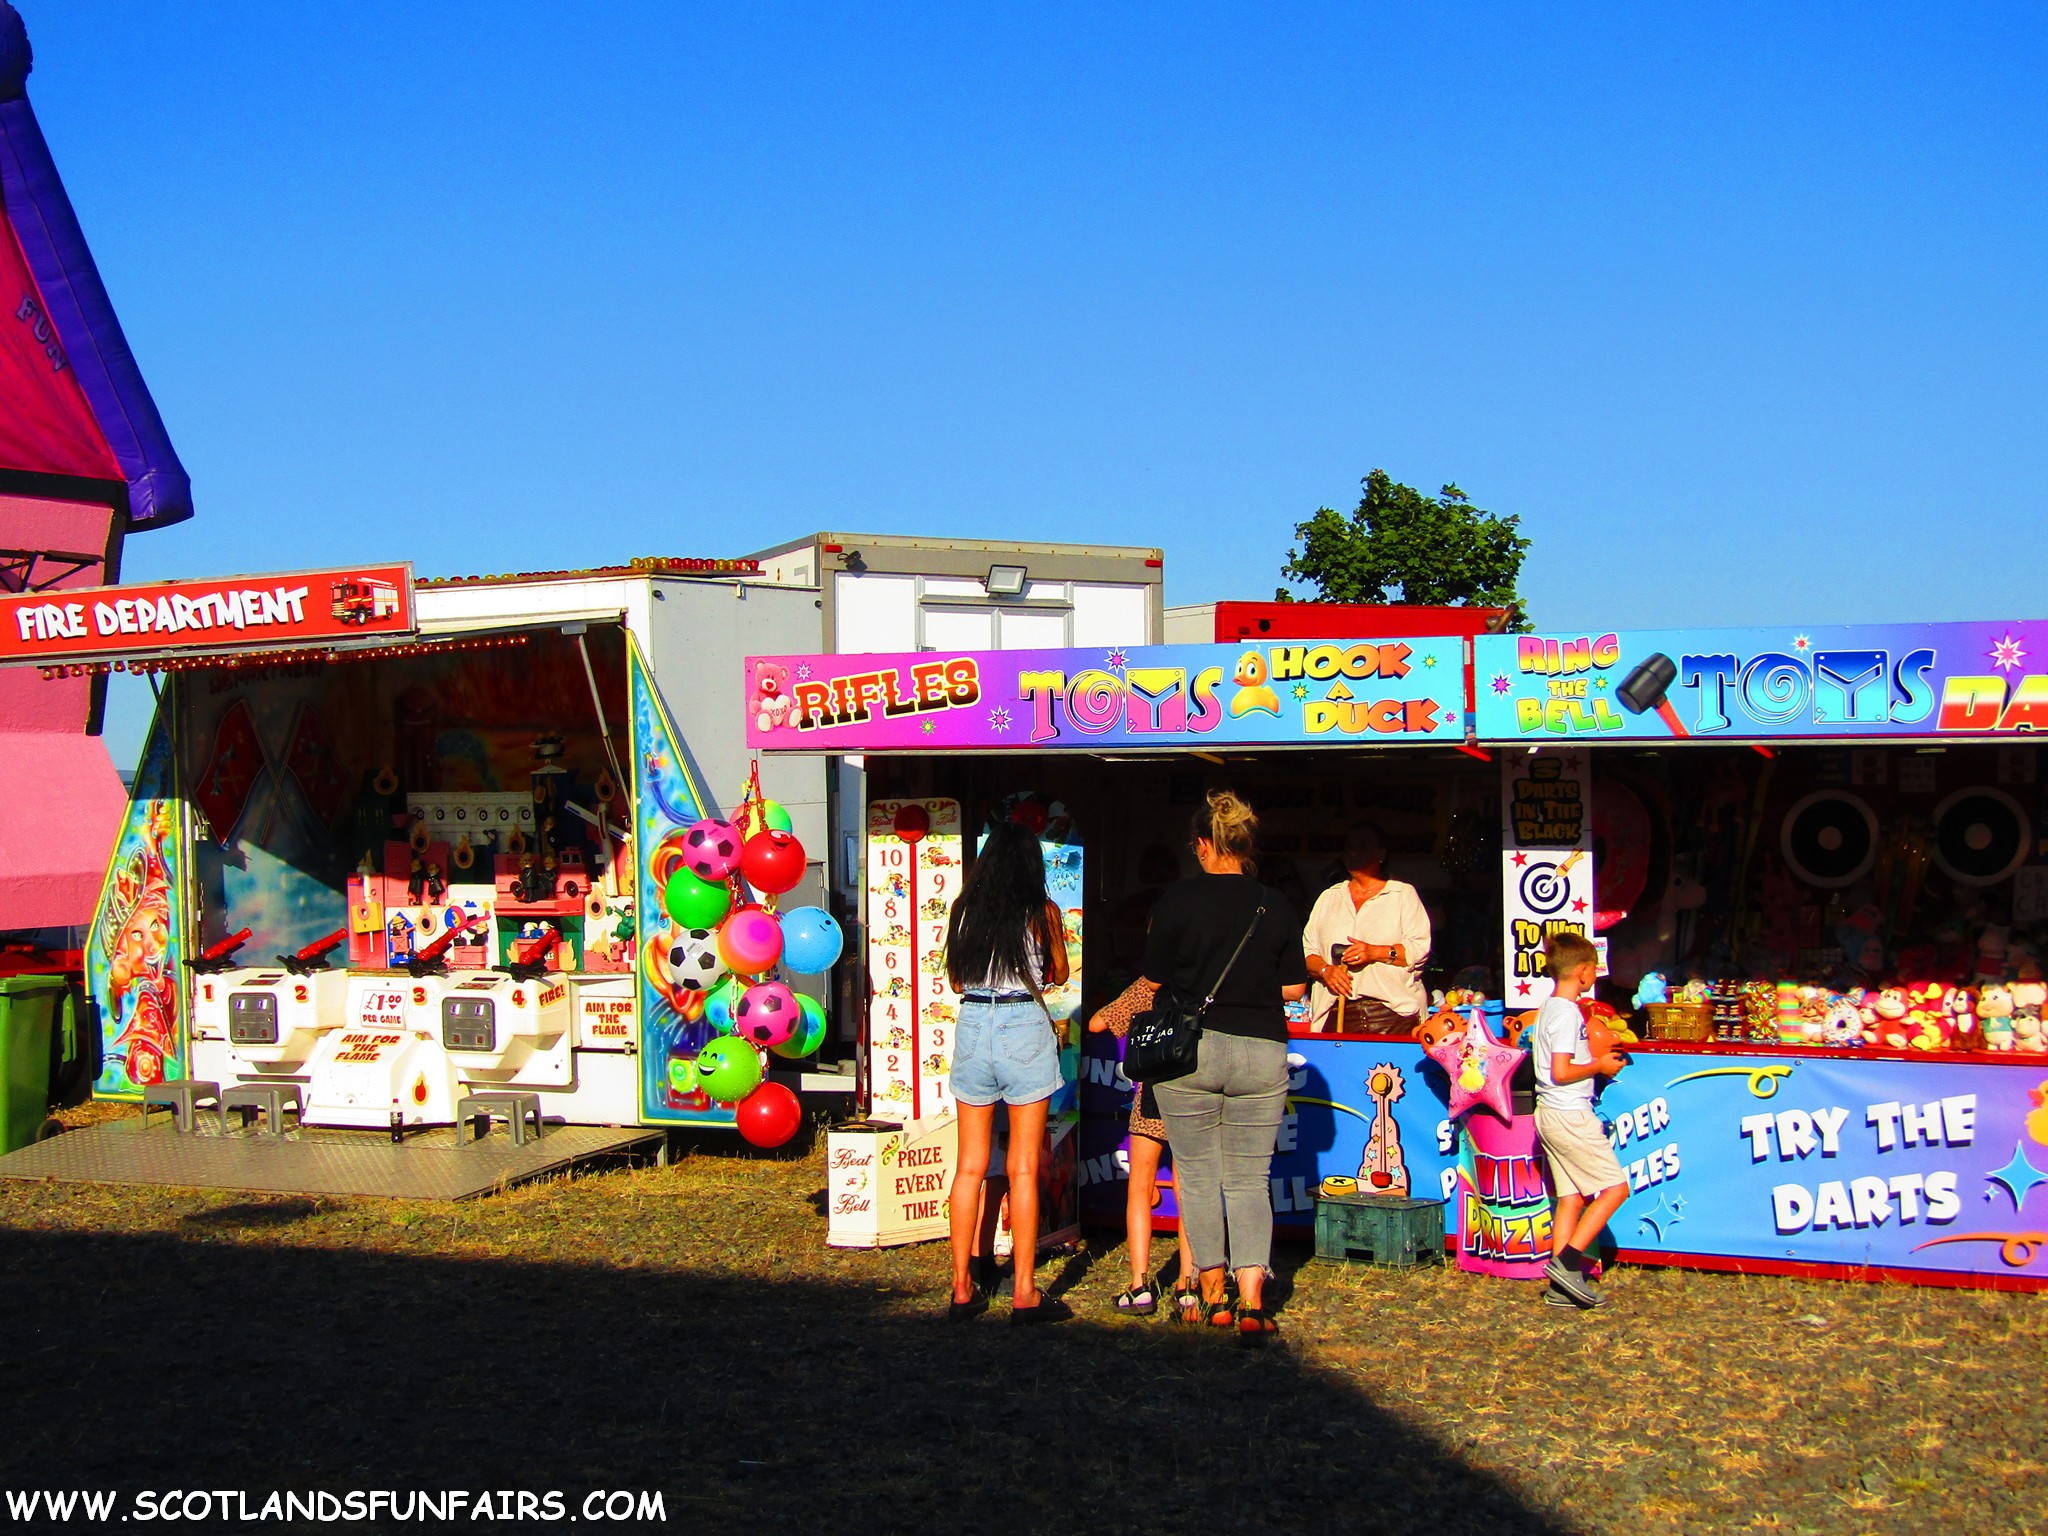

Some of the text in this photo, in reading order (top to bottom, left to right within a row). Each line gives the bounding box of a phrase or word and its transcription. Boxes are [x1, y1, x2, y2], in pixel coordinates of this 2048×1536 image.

[16, 585, 309, 641] FIRE DEPARTMENT
[1268, 641, 1415, 682] HOOK
[1516, 634, 1620, 675] RING
[792, 657, 981, 730] RIFLES
[1325, 680, 1355, 701] A
[1546, 679, 1588, 699] THE
[1681, 649, 1936, 733] TOYS
[1018, 664, 1225, 743] TOYS
[1302, 697, 1440, 735] DUCK
[1516, 698, 1625, 733] BELL
[1515, 780, 1580, 799] DARTS
[1513, 801, 1582, 820] IN THE
[1516, 822, 1581, 842] BLACK
[879, 850, 901, 866] 10
[934, 874, 945, 893] 9
[885, 901, 897, 918] 8
[932, 926, 944, 942] 7
[1513, 920, 1541, 947] TO
[886, 951, 897, 968] 6
[1516, 952, 1529, 973] A
[203, 983, 214, 1002] 1
[295, 985, 309, 1003] 2
[932, 977, 944, 995] 5
[364, 994, 402, 1011] £1.00
[412, 986, 427, 1006] 3
[511, 989, 527, 1008] 4
[538, 984, 567, 1008] FIRE!
[585, 1001, 633, 1014] AIM FOR
[886, 1004, 898, 1020] 4
[362, 1014, 402, 1025] PER GAME
[598, 1013, 620, 1025] THE
[340, 1033, 401, 1046] AIM FOR
[592, 1024, 628, 1036] FLAME
[933, 1030, 944, 1046] 3
[335, 1051, 381, 1062] FLAME
[352, 1043, 378, 1053] THE
[887, 1055, 899, 1072] 2
[935, 1082, 942, 1098] 1
[1741, 1093, 1977, 1163] TRY THE
[830, 1148, 874, 1169] Beat
[898, 1146, 943, 1169] PRIZE
[895, 1169, 947, 1196] EVERY
[1474, 1154, 1547, 1204] WIN
[833, 1193, 871, 1215] Bell
[902, 1200, 940, 1222] TIME
[1772, 1171, 1962, 1236] DARTS
